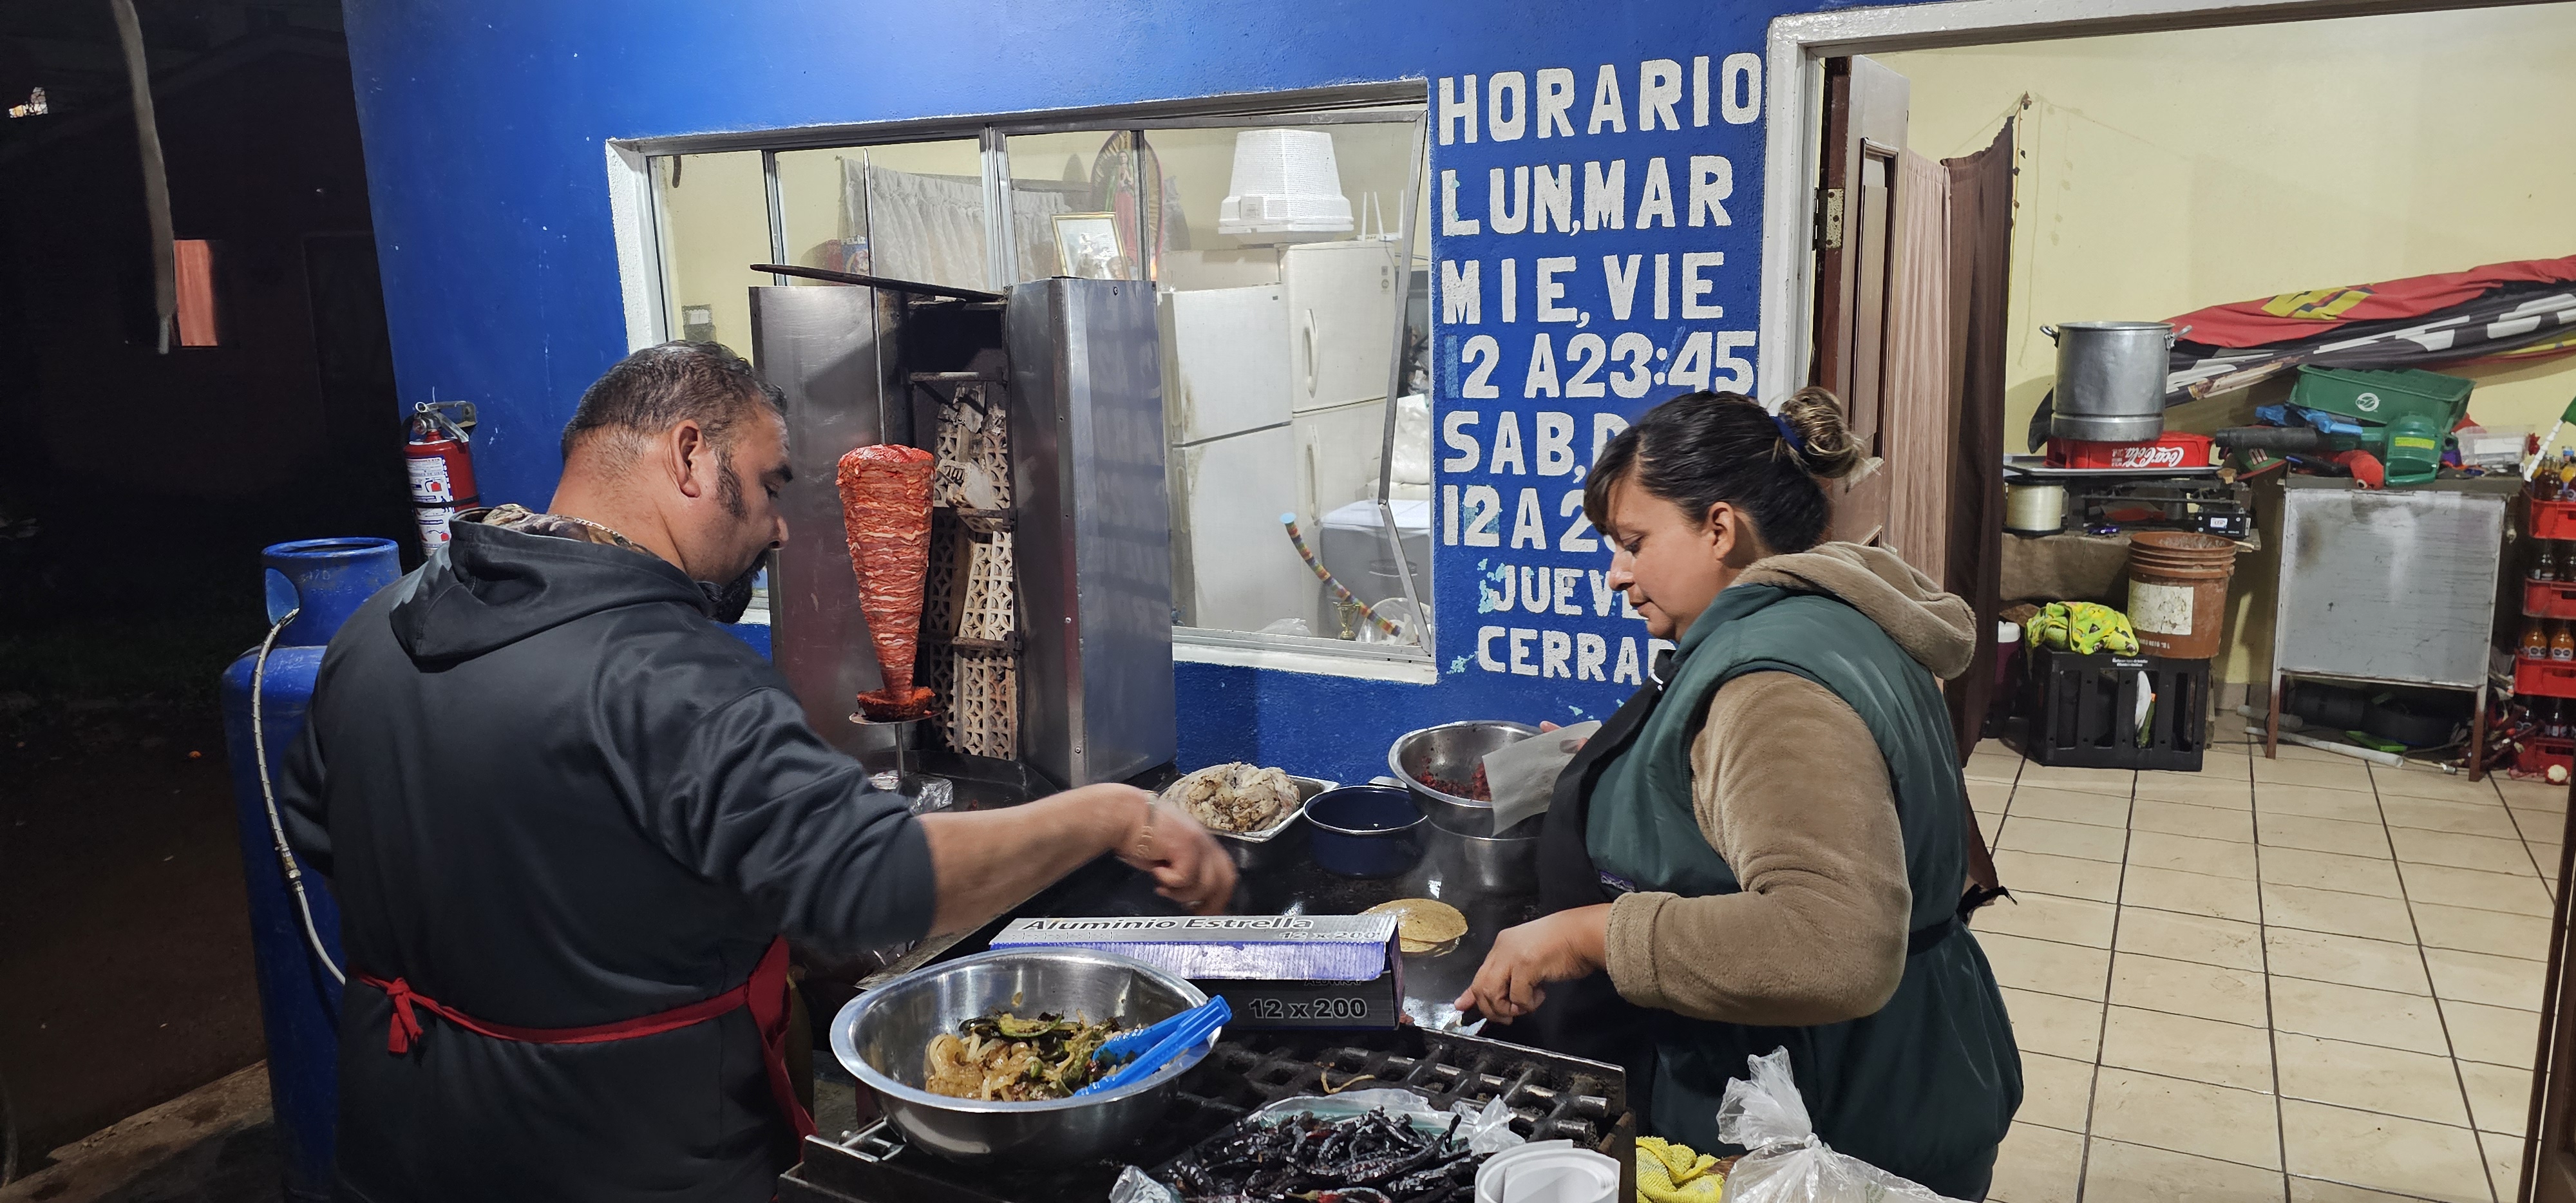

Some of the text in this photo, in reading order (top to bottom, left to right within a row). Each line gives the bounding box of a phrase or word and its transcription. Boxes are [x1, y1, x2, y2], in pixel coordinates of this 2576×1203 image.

[1439, 53, 1762, 146] HORARIO
[1443, 484, 1616, 553] 12 A 2
[1020, 915, 1315, 931] Aluminio Estrella
[1278, 931, 1309, 940] 12
[1332, 931, 1381, 940] 200
[1249, 998, 1367, 1019] 12 x 200
